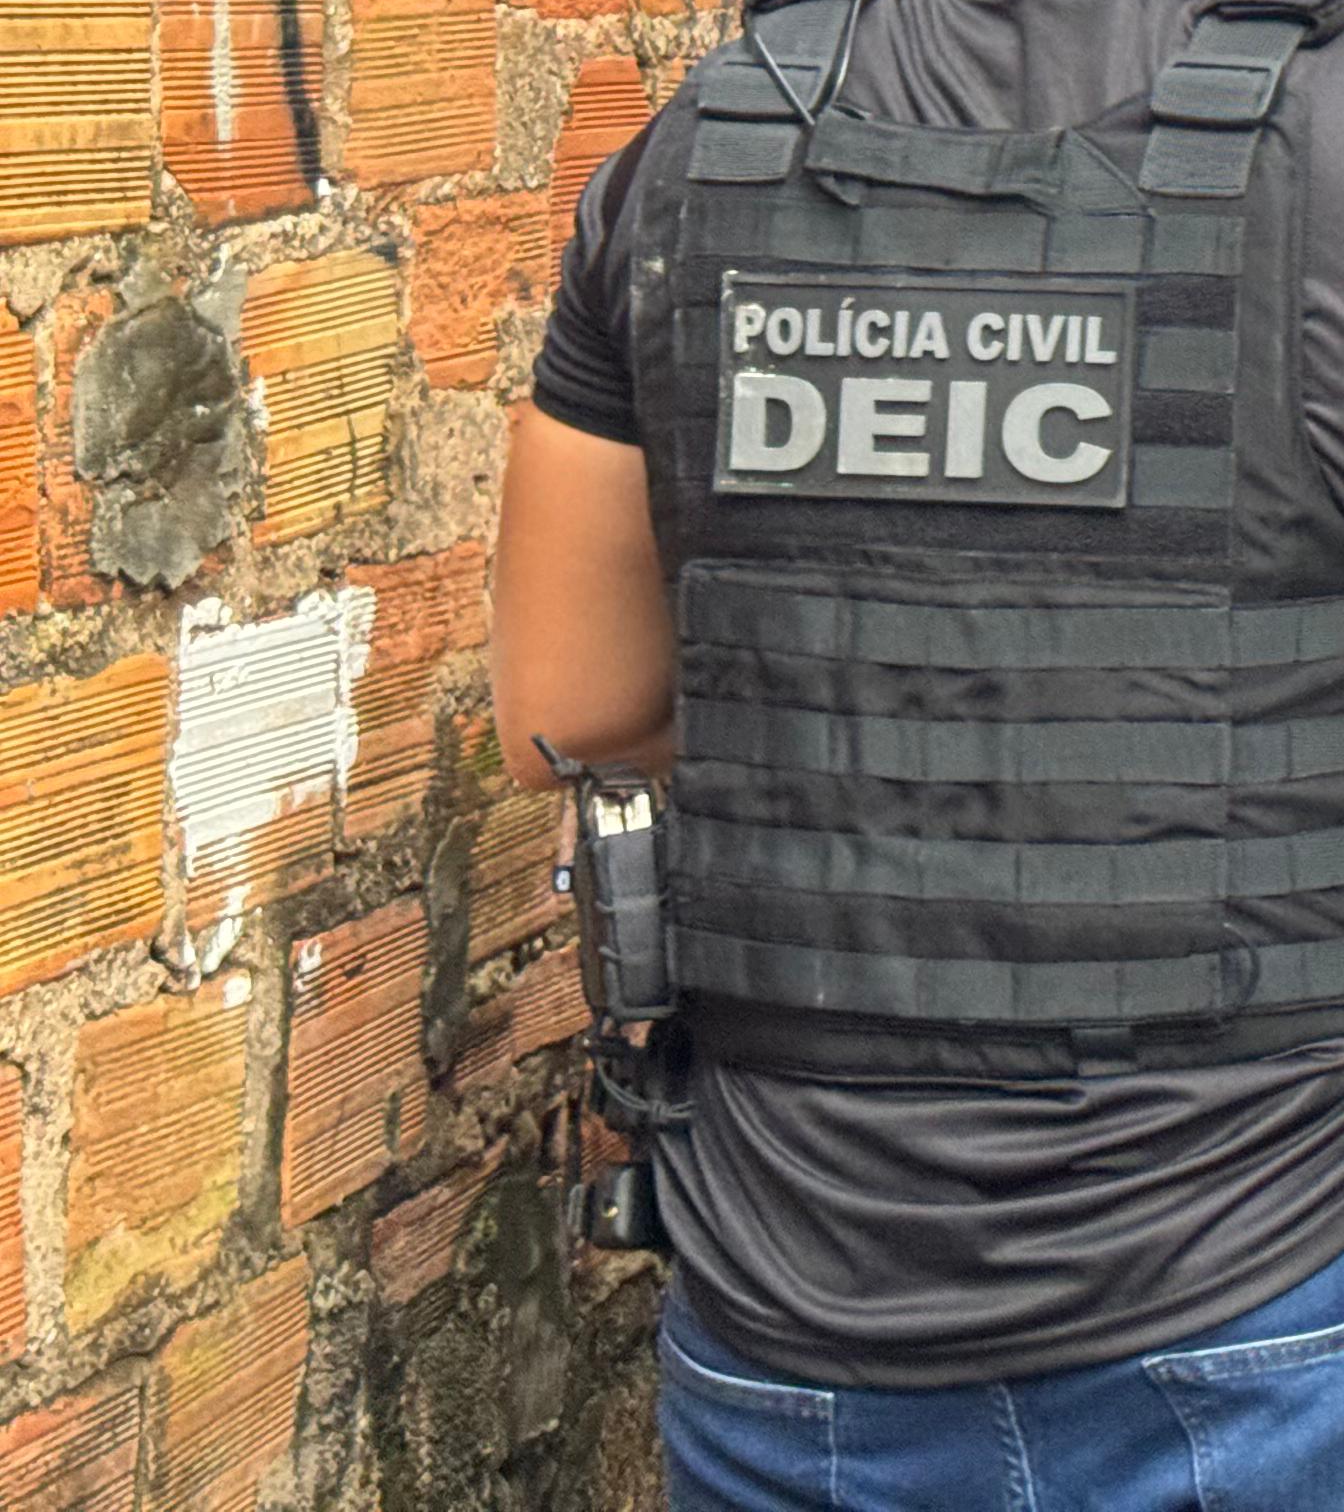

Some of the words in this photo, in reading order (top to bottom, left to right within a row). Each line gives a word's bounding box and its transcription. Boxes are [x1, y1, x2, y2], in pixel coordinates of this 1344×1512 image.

[733, 297, 949, 359] POLÍCIA
[966, 312, 1119, 364] CIVIL
[730, 372, 1113, 484] DEIC
